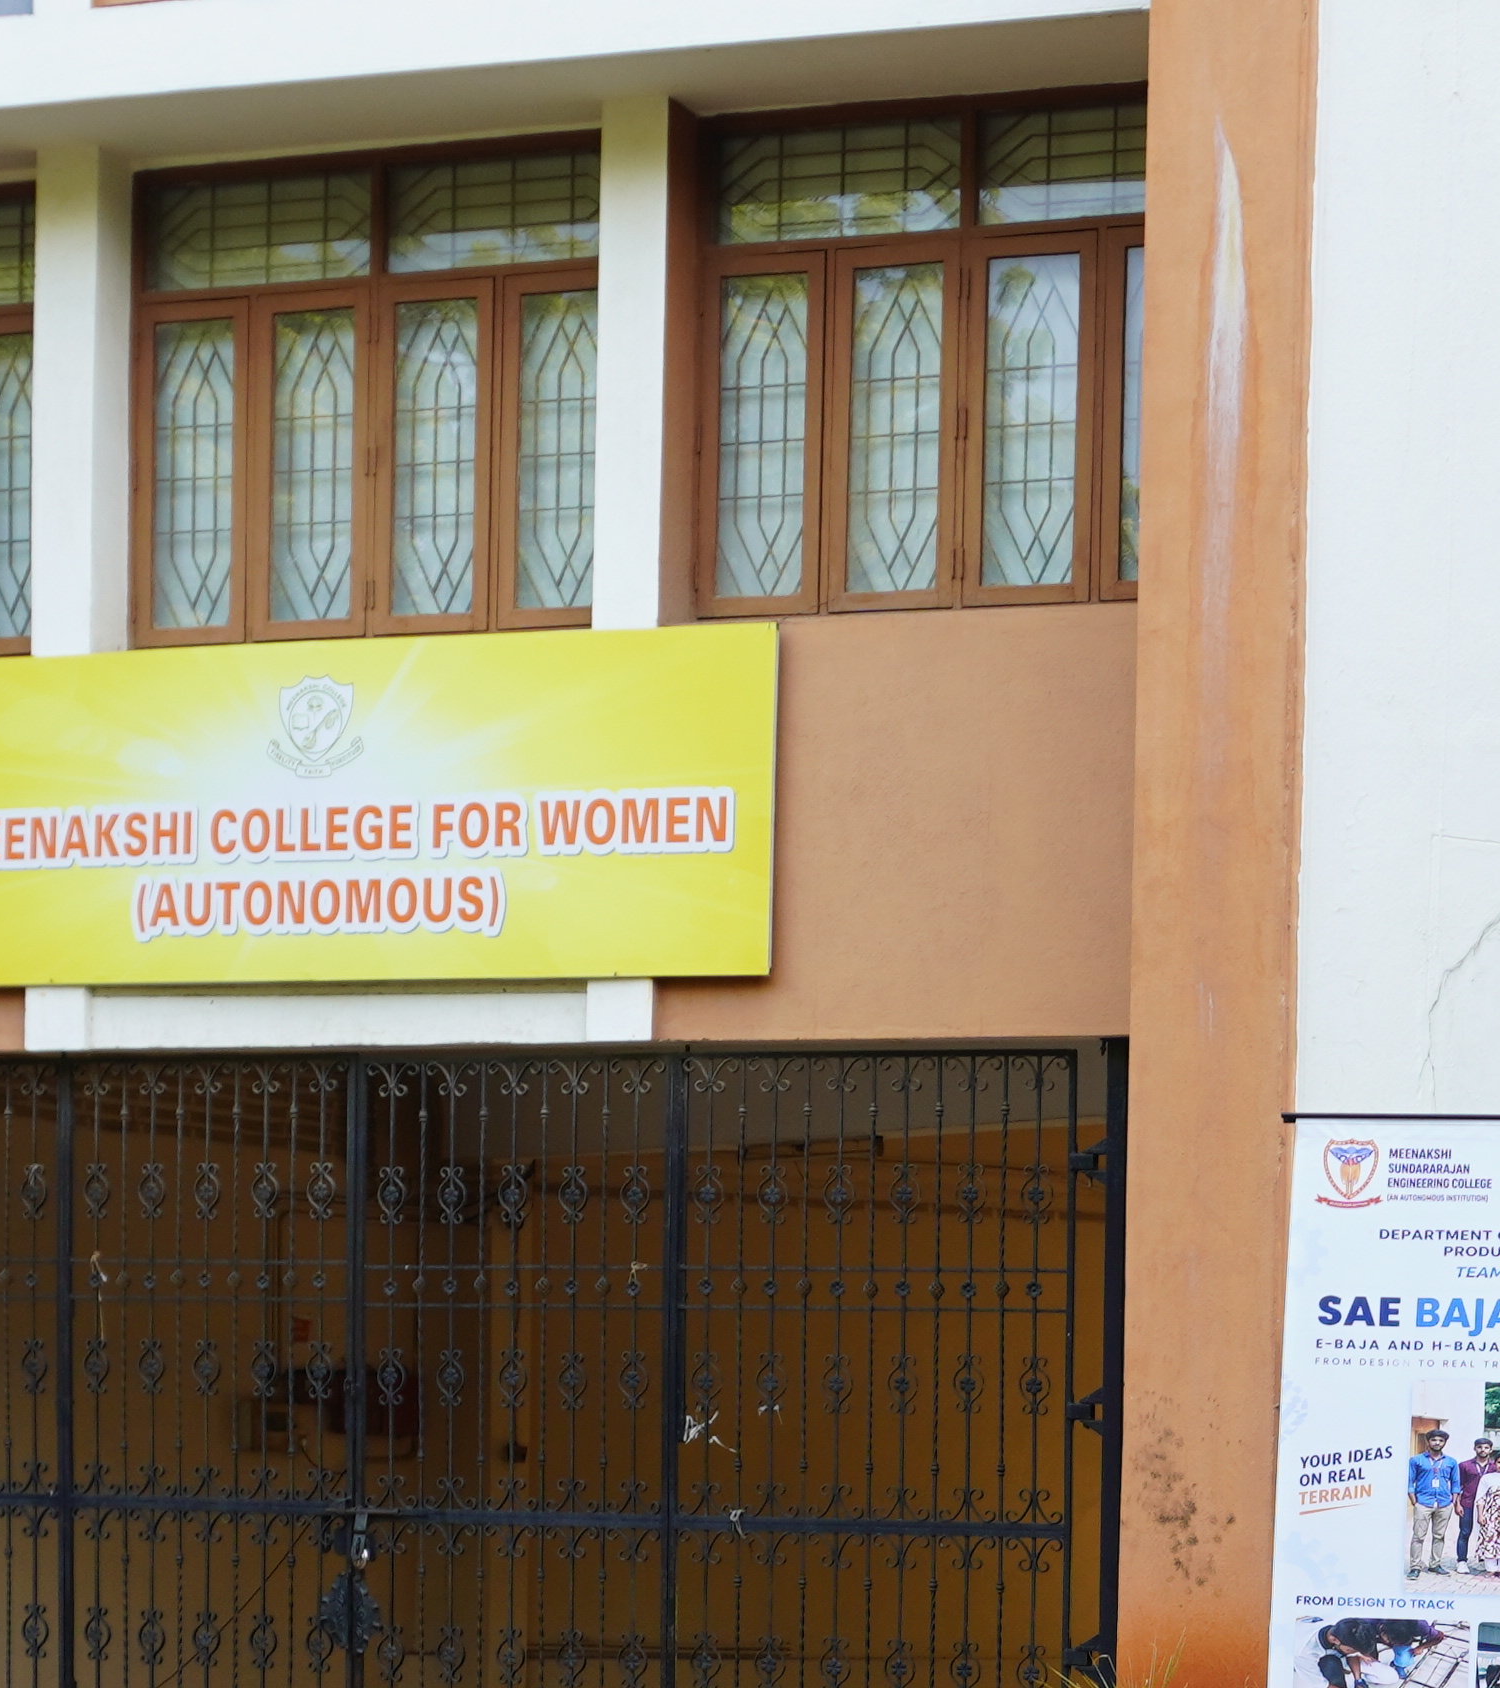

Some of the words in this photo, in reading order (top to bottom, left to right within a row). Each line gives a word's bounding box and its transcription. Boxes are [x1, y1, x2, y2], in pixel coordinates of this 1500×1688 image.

[210, 804, 413, 856] COLLEGE
[432, 801, 522, 849] FOR
[539, 795, 730, 846] WOMEN
[135, 875, 502, 933] (AUTONOMOUS)
[1389, 1148, 1452, 1160] MEENAKSHI
[1388, 1163, 1471, 1174] SUNDARARAJAN
[1387, 1177, 1450, 1189] ENGINEERING
[1451, 1178, 1493, 1189] COLLEGE
[1399, 1194, 1445, 1202] AUTONOMOUS
[1379, 1228, 1493, 1242] DEPARTMENT
[1318, 1295, 1401, 1327] SAE
[1316, 1338, 1380, 1351] E-BAJA
[1388, 1339, 1425, 1351] AND
[1432, 1340, 1500, 1353] H-BAJA
[1314, 1357, 1352, 1366] FROM
[1359, 1357, 1411, 1367] DESIGN
[1418, 1358, 1437, 1368] TO
[1442, 1359, 1476, 1369] REAL
[1300, 1452, 1342, 1469] YOUR
[1348, 1445, 1393, 1463] IDEAS
[1299, 1472, 1322, 1487] ON
[1328, 1467, 1366, 1484] REAL
[1298, 1483, 1373, 1506] TERRAIN
[1296, 1595, 1334, 1606] FROM
[1337, 1596, 1385, 1608] DESIGN
[1389, 1598, 1407, 1608] TO
[1410, 1599, 1455, 1610] TRACK
